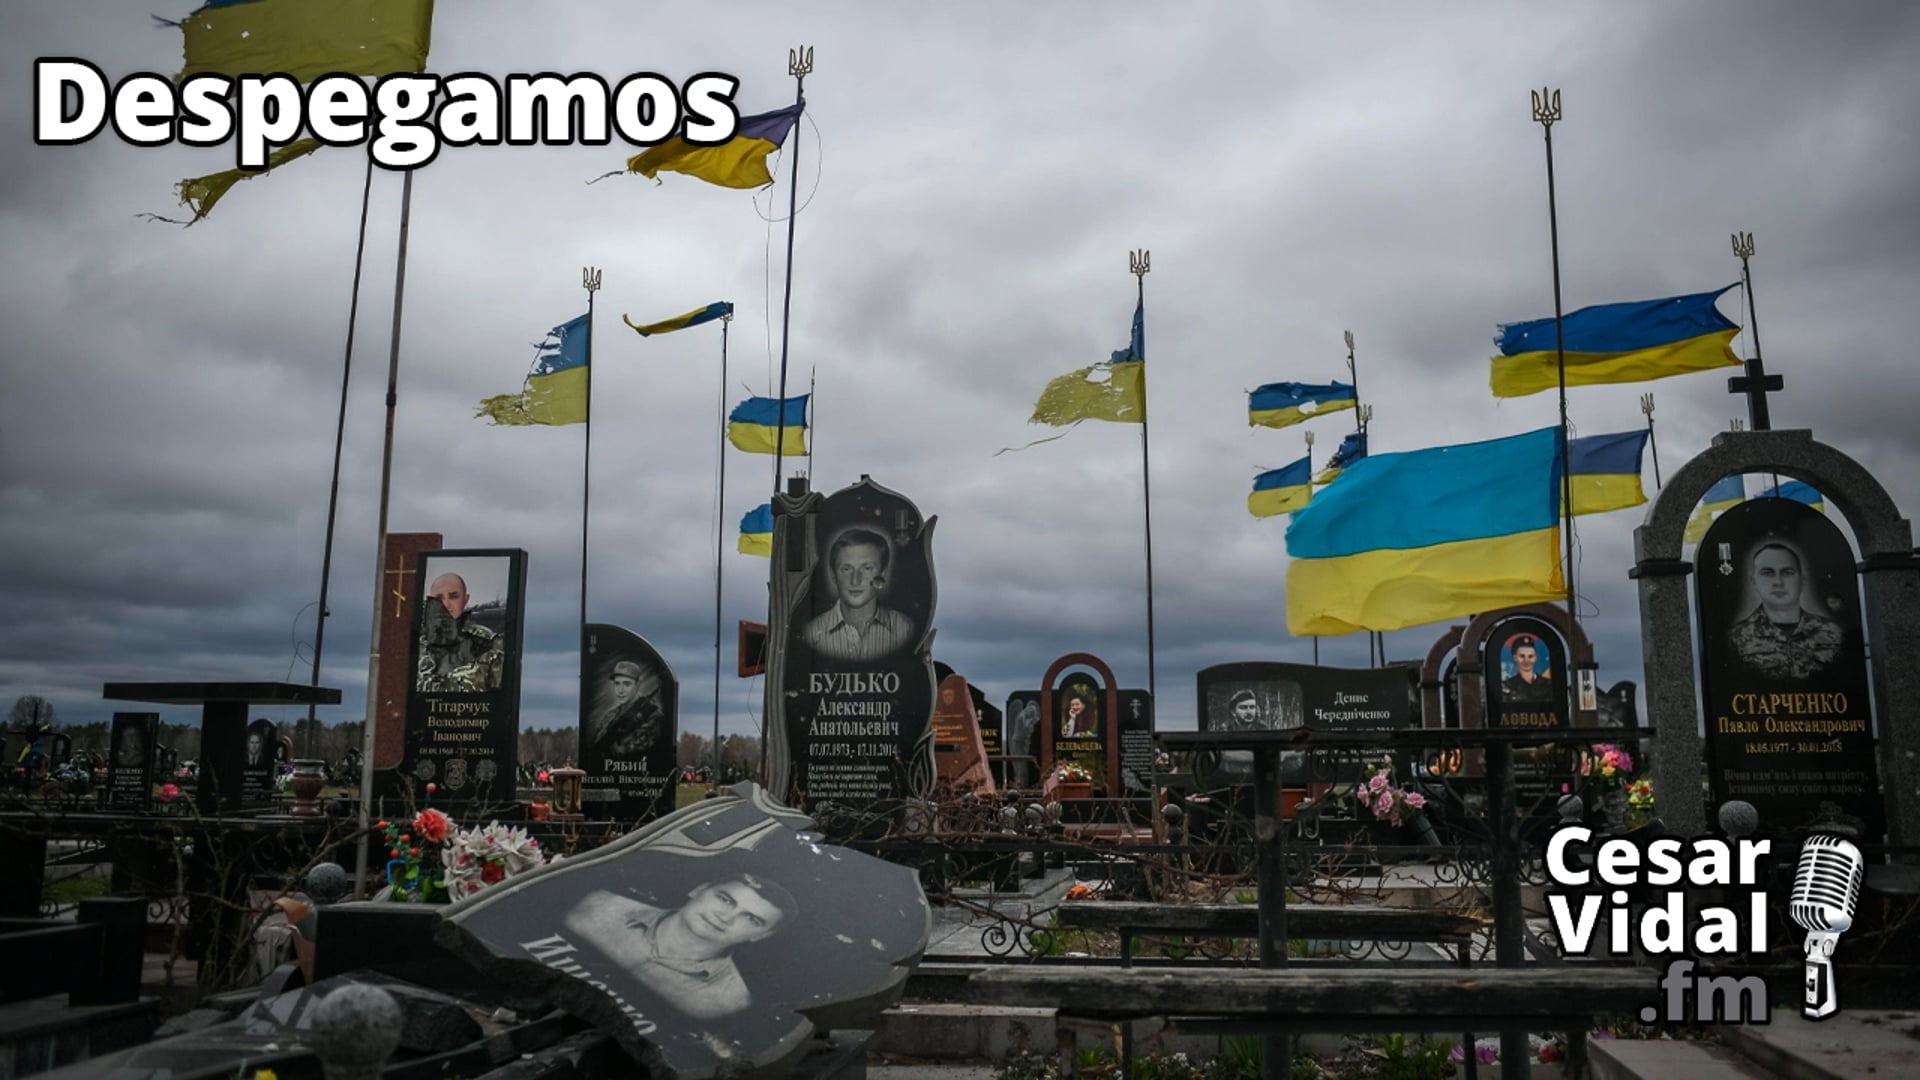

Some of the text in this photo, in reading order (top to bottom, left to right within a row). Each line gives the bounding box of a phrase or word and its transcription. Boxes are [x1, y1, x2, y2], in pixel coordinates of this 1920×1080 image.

[809, 672, 900, 697] БУДЬКО
[425, 698, 490, 716] Тітарчук
[817, 698, 891, 720] Александр
[1732, 693, 1848, 715] СТАРЧЕНКО
[809, 717, 900, 736] Анатольевич
[1718, 716, 1866, 736] Павло Олександрович
